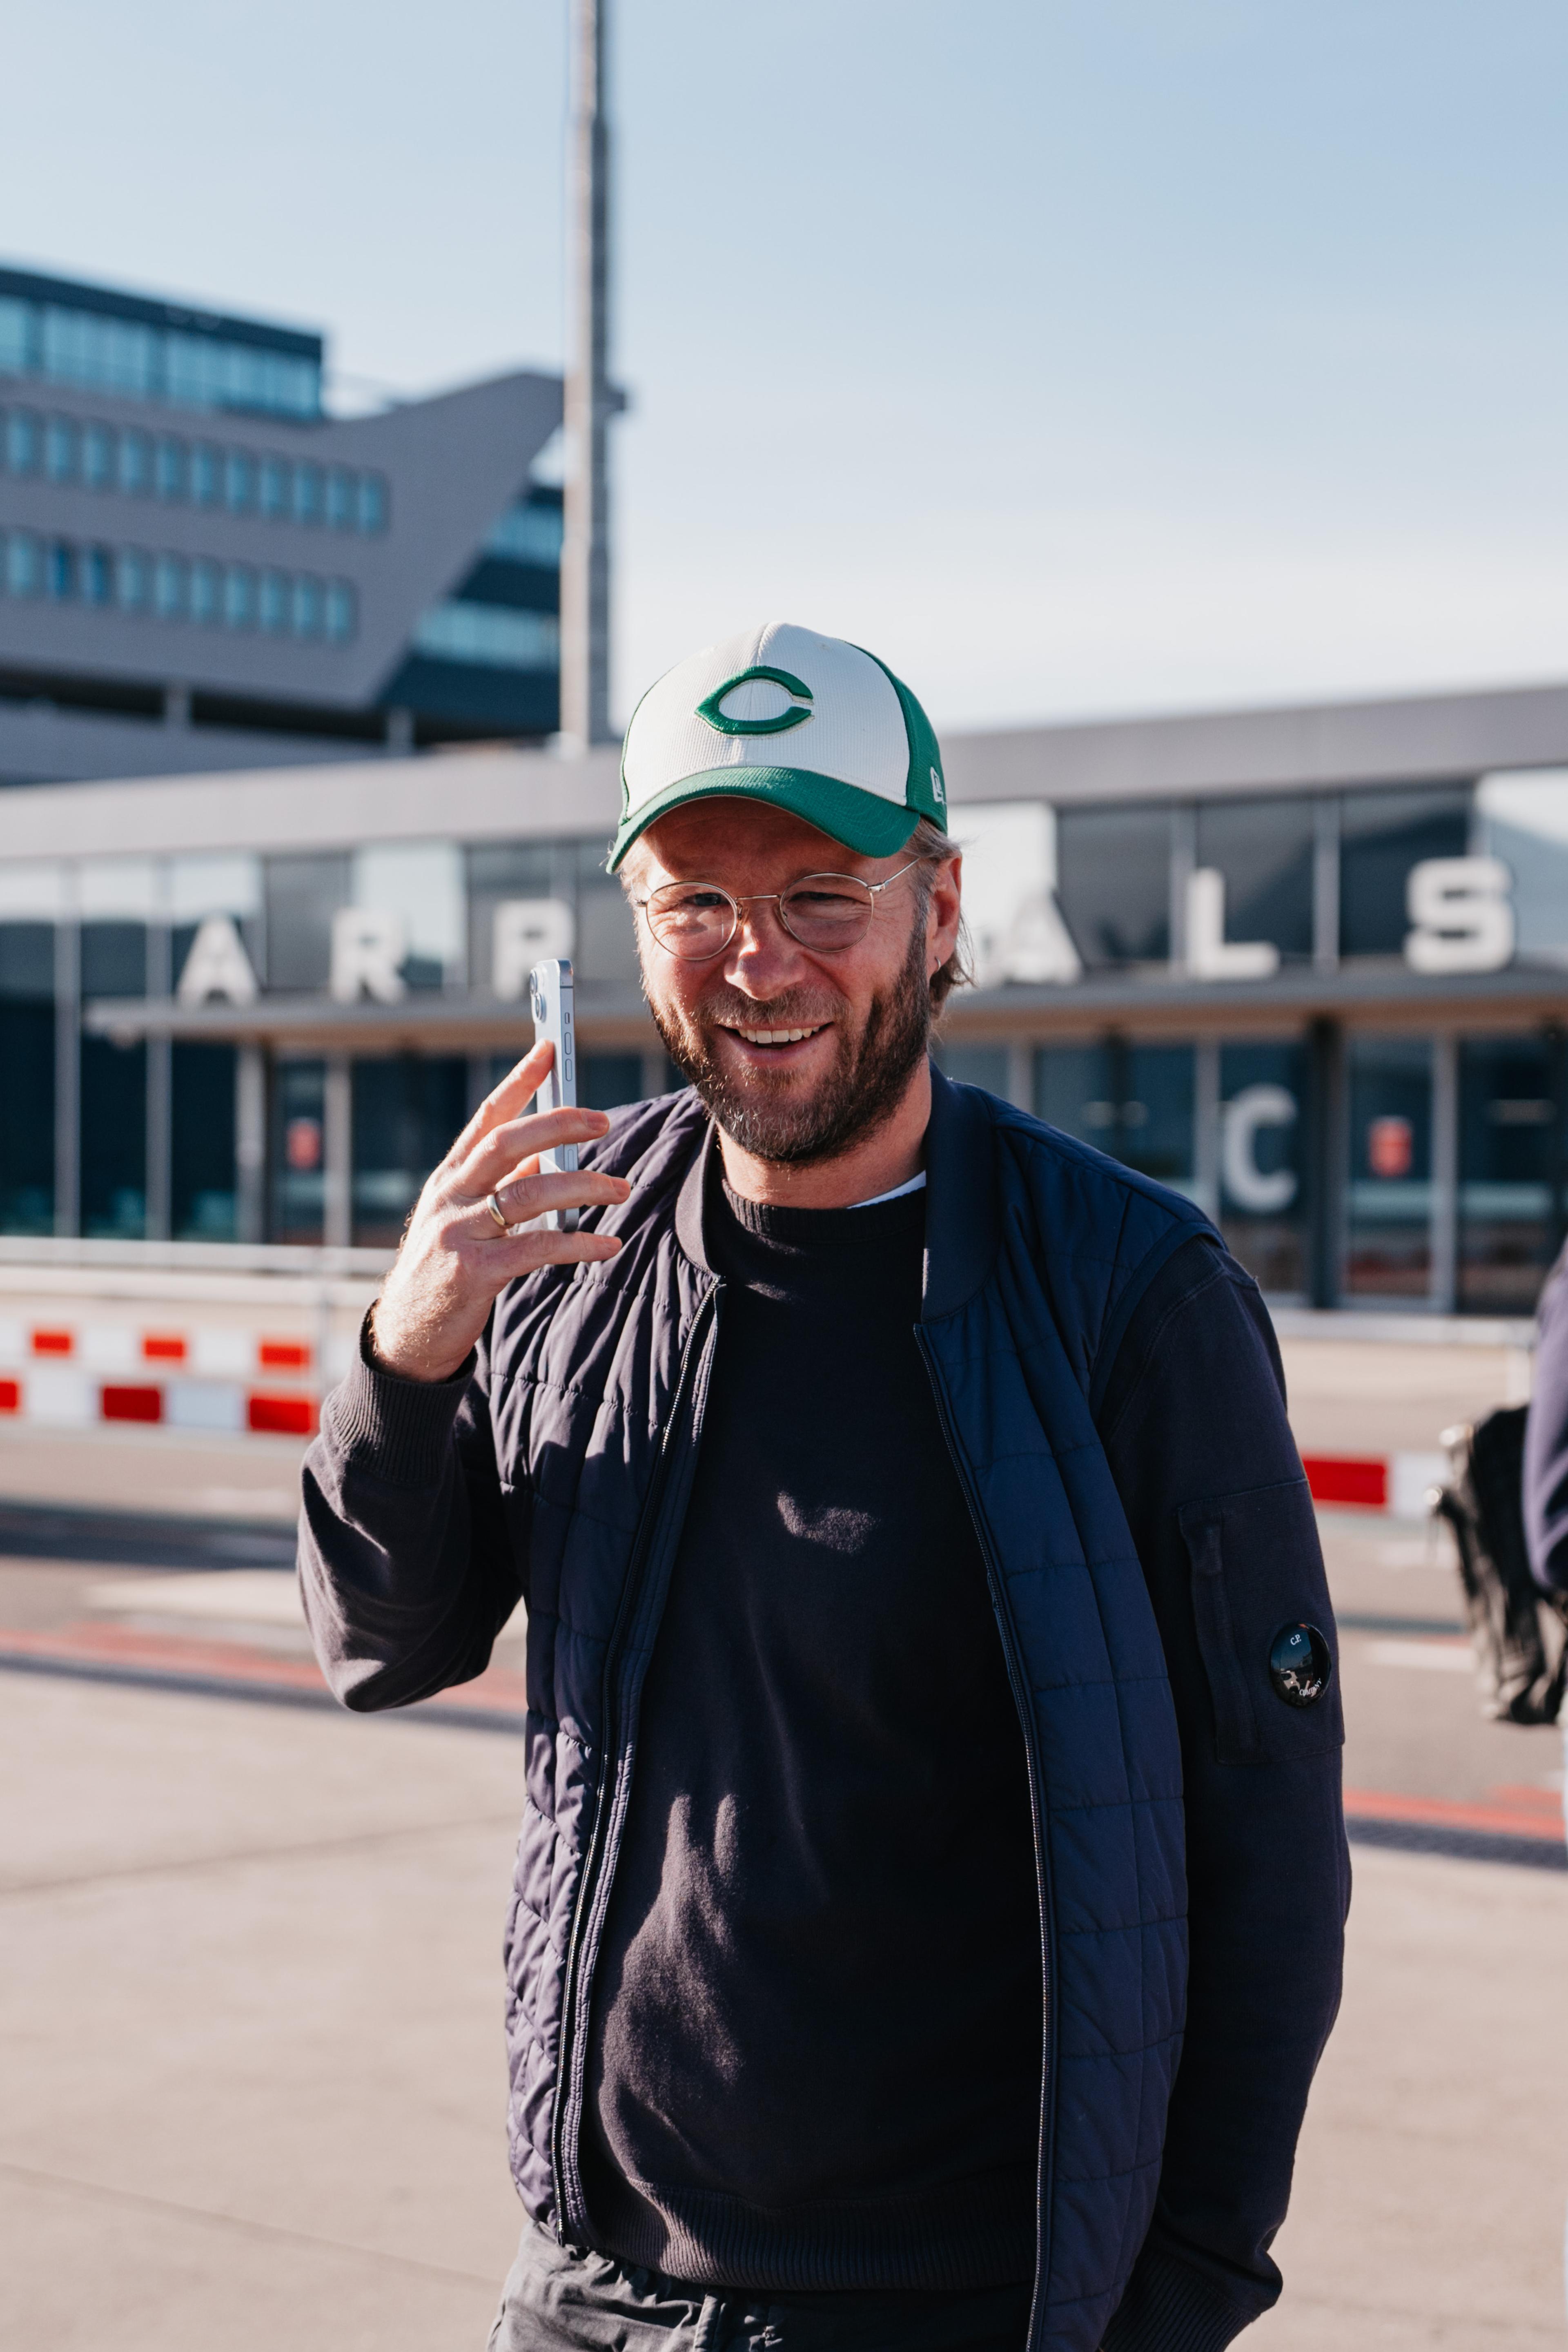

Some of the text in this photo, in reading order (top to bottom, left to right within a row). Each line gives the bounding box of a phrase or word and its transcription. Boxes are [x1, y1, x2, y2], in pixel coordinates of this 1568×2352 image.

[695, 665, 814, 739] C
[1224, 1083, 1298, 1213] C
[1290, 1634, 1302, 1645] C.P.
